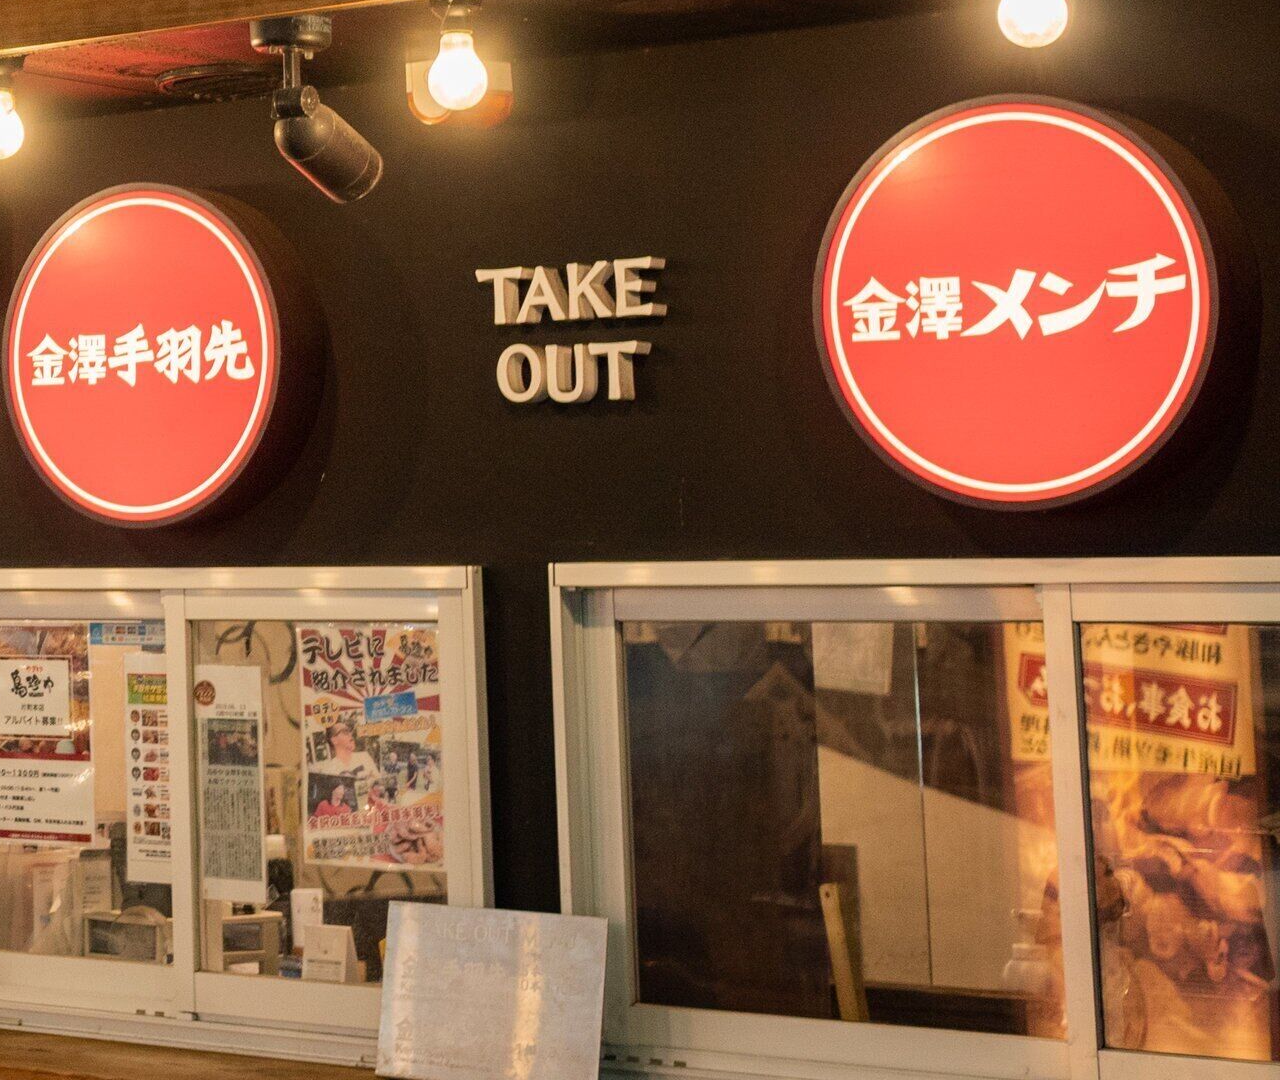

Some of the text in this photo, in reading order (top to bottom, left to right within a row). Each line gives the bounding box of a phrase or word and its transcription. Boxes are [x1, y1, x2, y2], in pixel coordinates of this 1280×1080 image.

[475, 256, 666, 326] TAKE
[843, 253, 1186, 342] 金澤メンチ
[26, 320, 255, 387] 金澤手羽先
[496, 340, 652, 404] OUT
[302, 631, 385, 665] テレビに
[312, 661, 439, 693] 紹介されました
[4, 715, 41, 725] アルバイト
